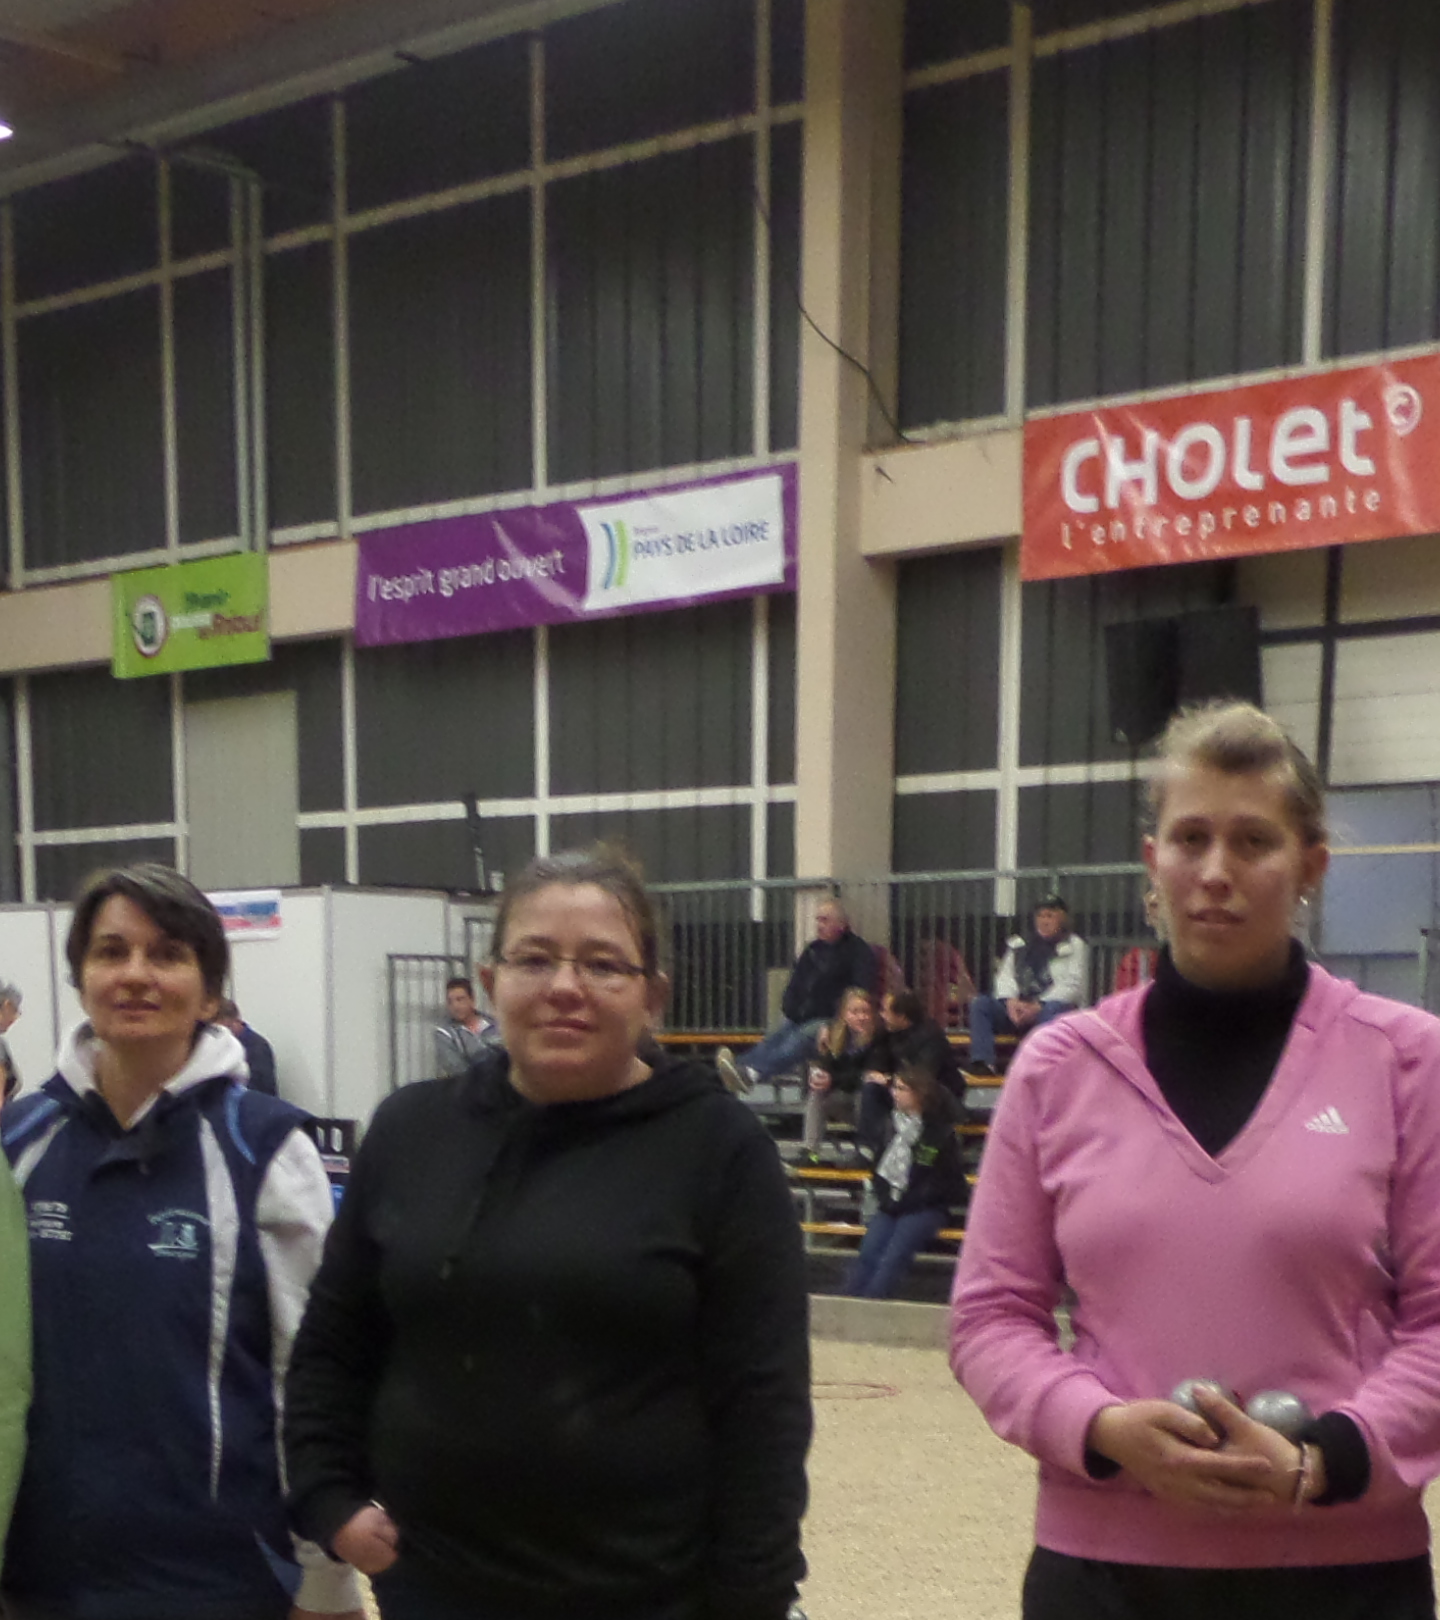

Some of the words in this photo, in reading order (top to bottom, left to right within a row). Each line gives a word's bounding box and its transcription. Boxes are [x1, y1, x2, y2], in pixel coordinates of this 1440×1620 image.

[633, 533, 672, 560] PAYS
[676, 531, 695, 554] DE
[698, 528, 720, 550] LA
[721, 520, 769, 547] LOIRE
[1061, 484, 1381, 550] l'entreprenante
[367, 565, 435, 603] l'esprit
[438, 556, 495, 597] grand
[496, 550, 566, 582] ouvert
